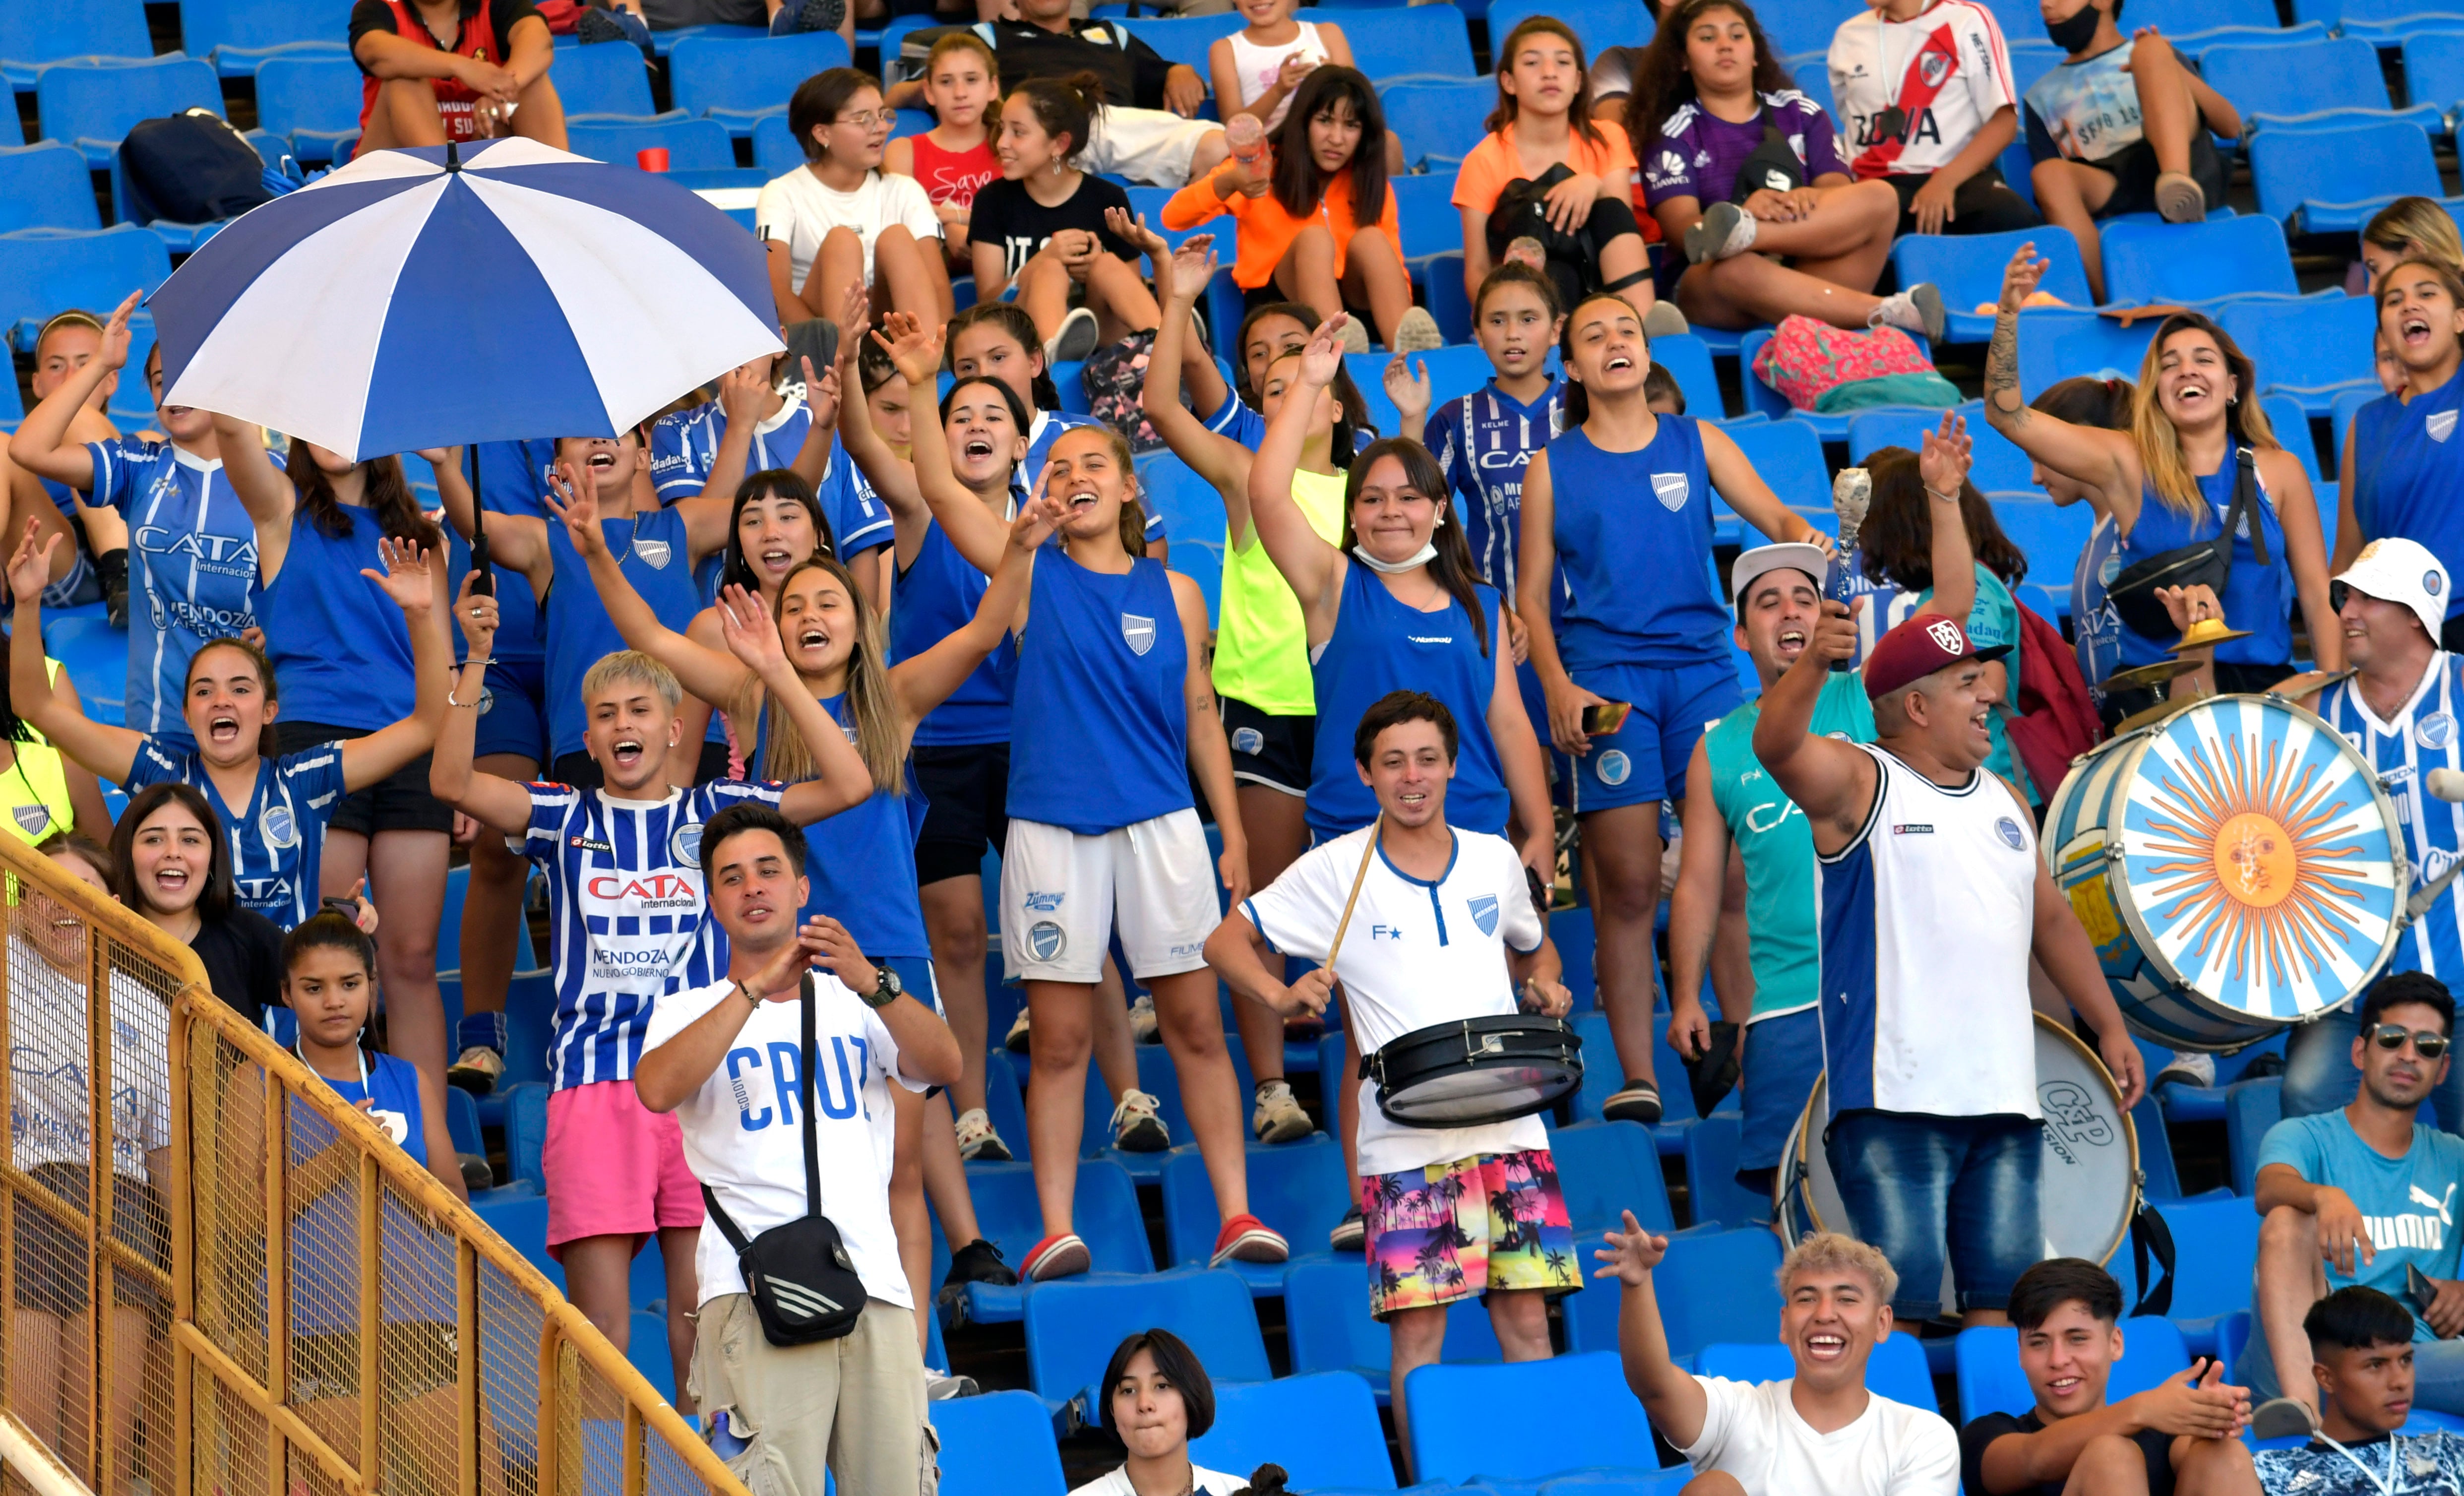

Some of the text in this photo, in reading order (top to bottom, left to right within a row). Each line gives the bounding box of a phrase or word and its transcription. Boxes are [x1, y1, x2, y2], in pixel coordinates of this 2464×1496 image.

[1481, 420, 1509, 429] KELME
[135, 525, 258, 562] CATA
[588, 874, 695, 900] CATA
[641, 897, 696, 909] Internacional
[593, 948, 670, 965] MENDOZA
[592, 966, 670, 979] NUEVO GOBIERNO
[730, 1077, 749, 1110] GODOY
